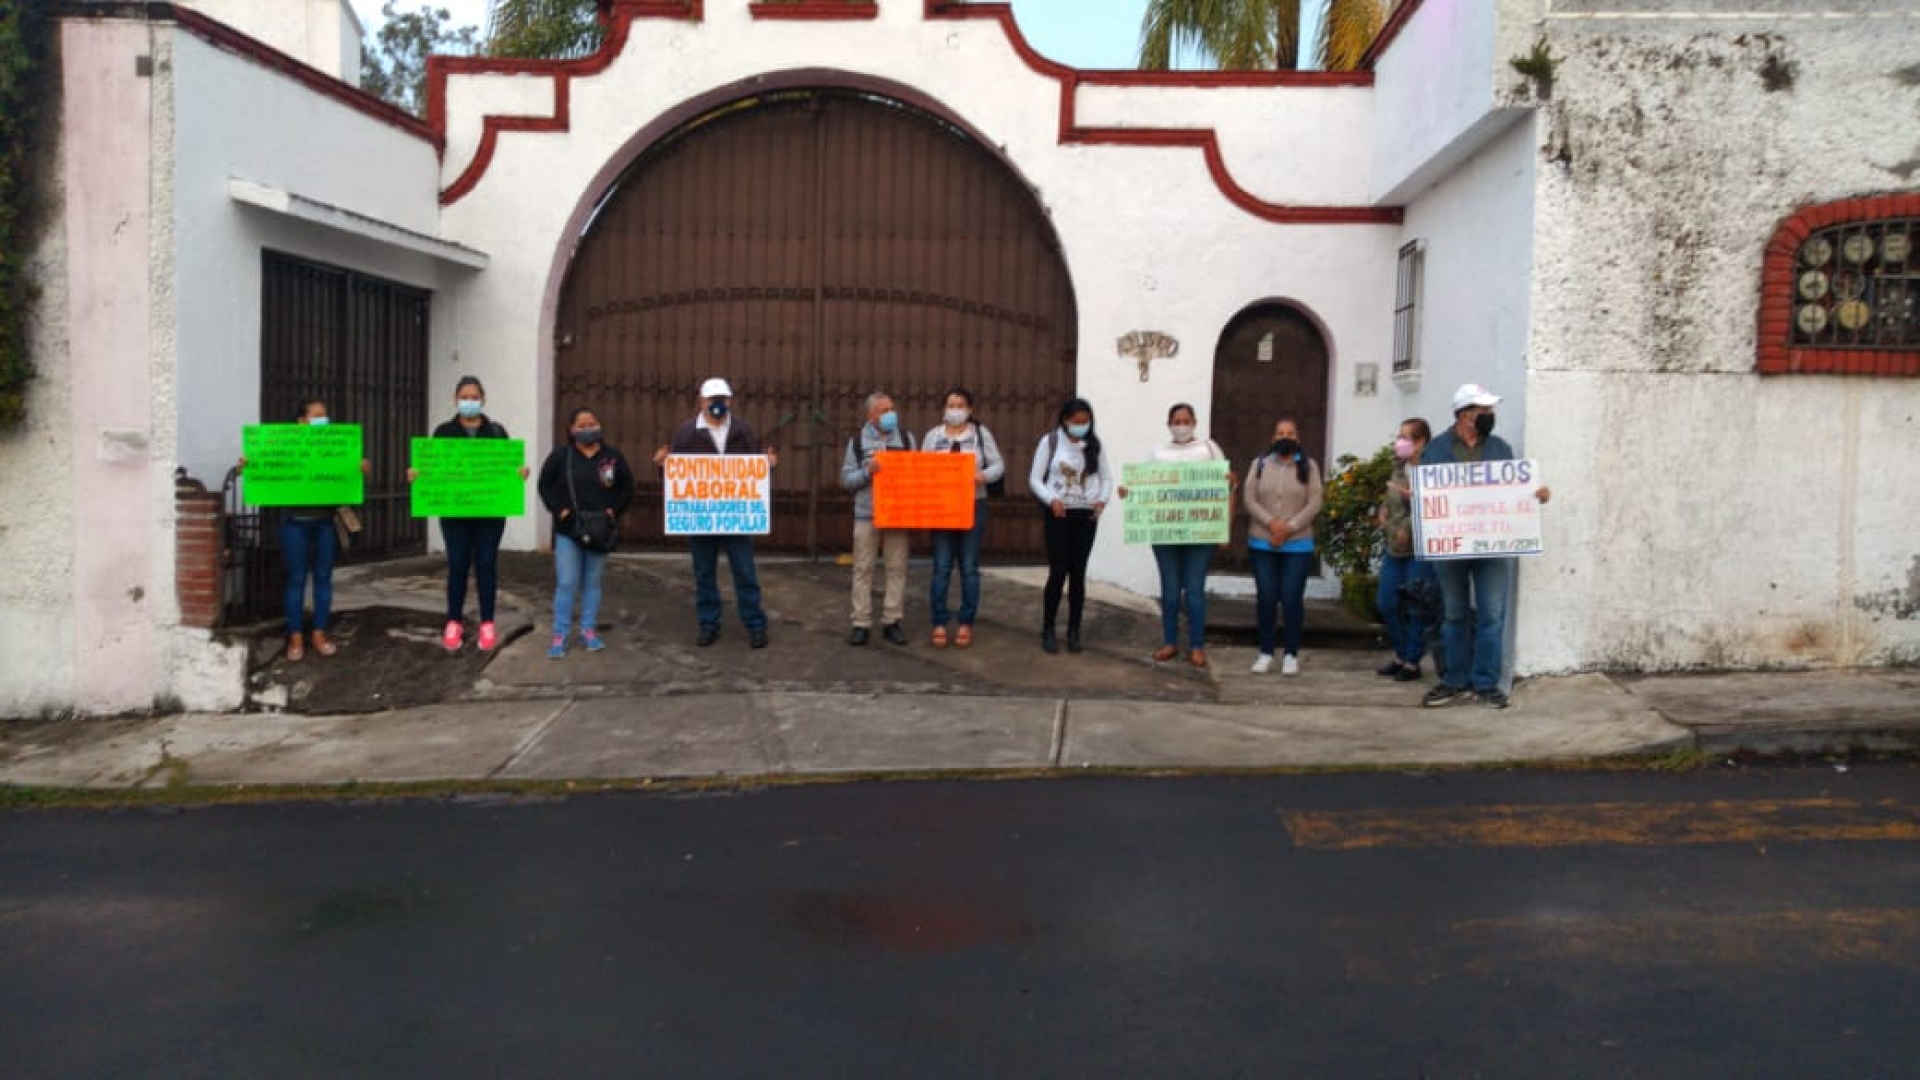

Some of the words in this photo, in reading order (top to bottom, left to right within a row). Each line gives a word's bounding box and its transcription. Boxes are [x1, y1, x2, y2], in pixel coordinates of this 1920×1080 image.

[667, 457, 767, 480] CONTINUIDAD
[1422, 460, 1532, 488] MORELOS
[672, 481, 762, 499] LABORAL
[1423, 495, 1448, 519] NO
[667, 515, 713, 532] SEGURO
[715, 515, 767, 532] POPULAR
[1427, 537, 1462, 555] DOF
